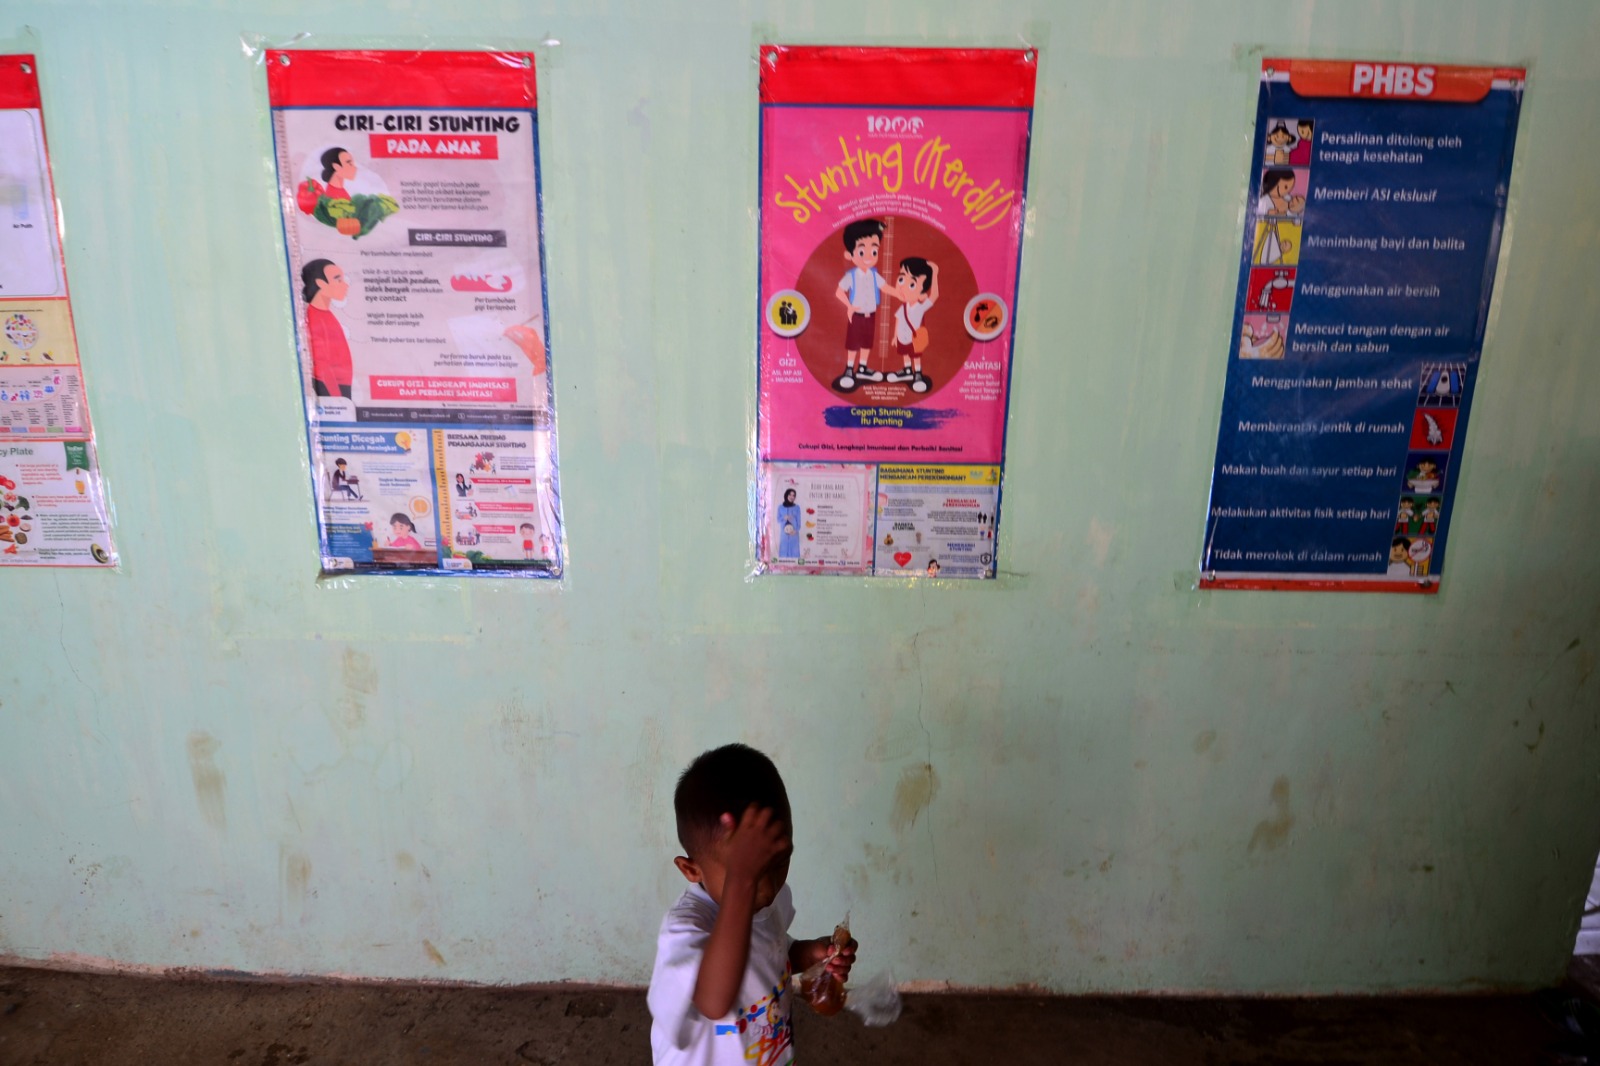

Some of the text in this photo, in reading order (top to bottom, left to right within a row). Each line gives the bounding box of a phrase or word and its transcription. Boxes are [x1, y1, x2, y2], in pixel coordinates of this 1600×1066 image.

[1353, 64, 1436, 96] PHBS
[335, 115, 520, 133] CIRI-CIRI STUNTING
[387, 139, 481, 155] PADA ANAK
[1321, 132, 1462, 149] Persalinan ditolong oleh
[1319, 149, 1423, 165] tenaga kesehatan
[775, 136, 903, 223] Stunting
[1314, 187, 1437, 202] Memberi ASI ekslusif
[415, 233, 493, 242] CIRI-CIRI STUNTING
[1307, 235, 1465, 252] Menimbang bayi dan balita
[384, 286, 410, 294] banyak
[1301, 283, 1440, 298] Menggunakan air bersih
[1294, 323, 1450, 339] Mencuci tangan dengan air
[1292, 340, 1390, 353] bersih dan sabun
[779, 358, 796, 367] GIZI
[964, 361, 1001, 370] SANITASI
[428, 380, 467, 389] LENGKAPI
[469, 381, 510, 389] IMUNISASI
[1251, 376, 1413, 391] Menggunakan jamban sehat
[399, 388, 416, 396] DAN
[455, 389, 492, 398] SANITASI
[851, 408, 914, 419] Cegah Stunting,
[861, 417, 903, 427] Itu Penting
[1238, 421, 1405, 434] Memberantas jentik di rumah
[351, 434, 386, 444] Dicegah
[10, 447, 34, 455] Plate
[798, 443, 820, 451] Cukupi
[836, 444, 866, 452] Lengkapi
[1222, 464, 1396, 479] Makan buah dan sayur setiap hari
[1211, 506, 1390, 521] Melakukan aktivitas fisik setiap hari
[1214, 549, 1382, 562] Tidak merokok di dalam rumah
